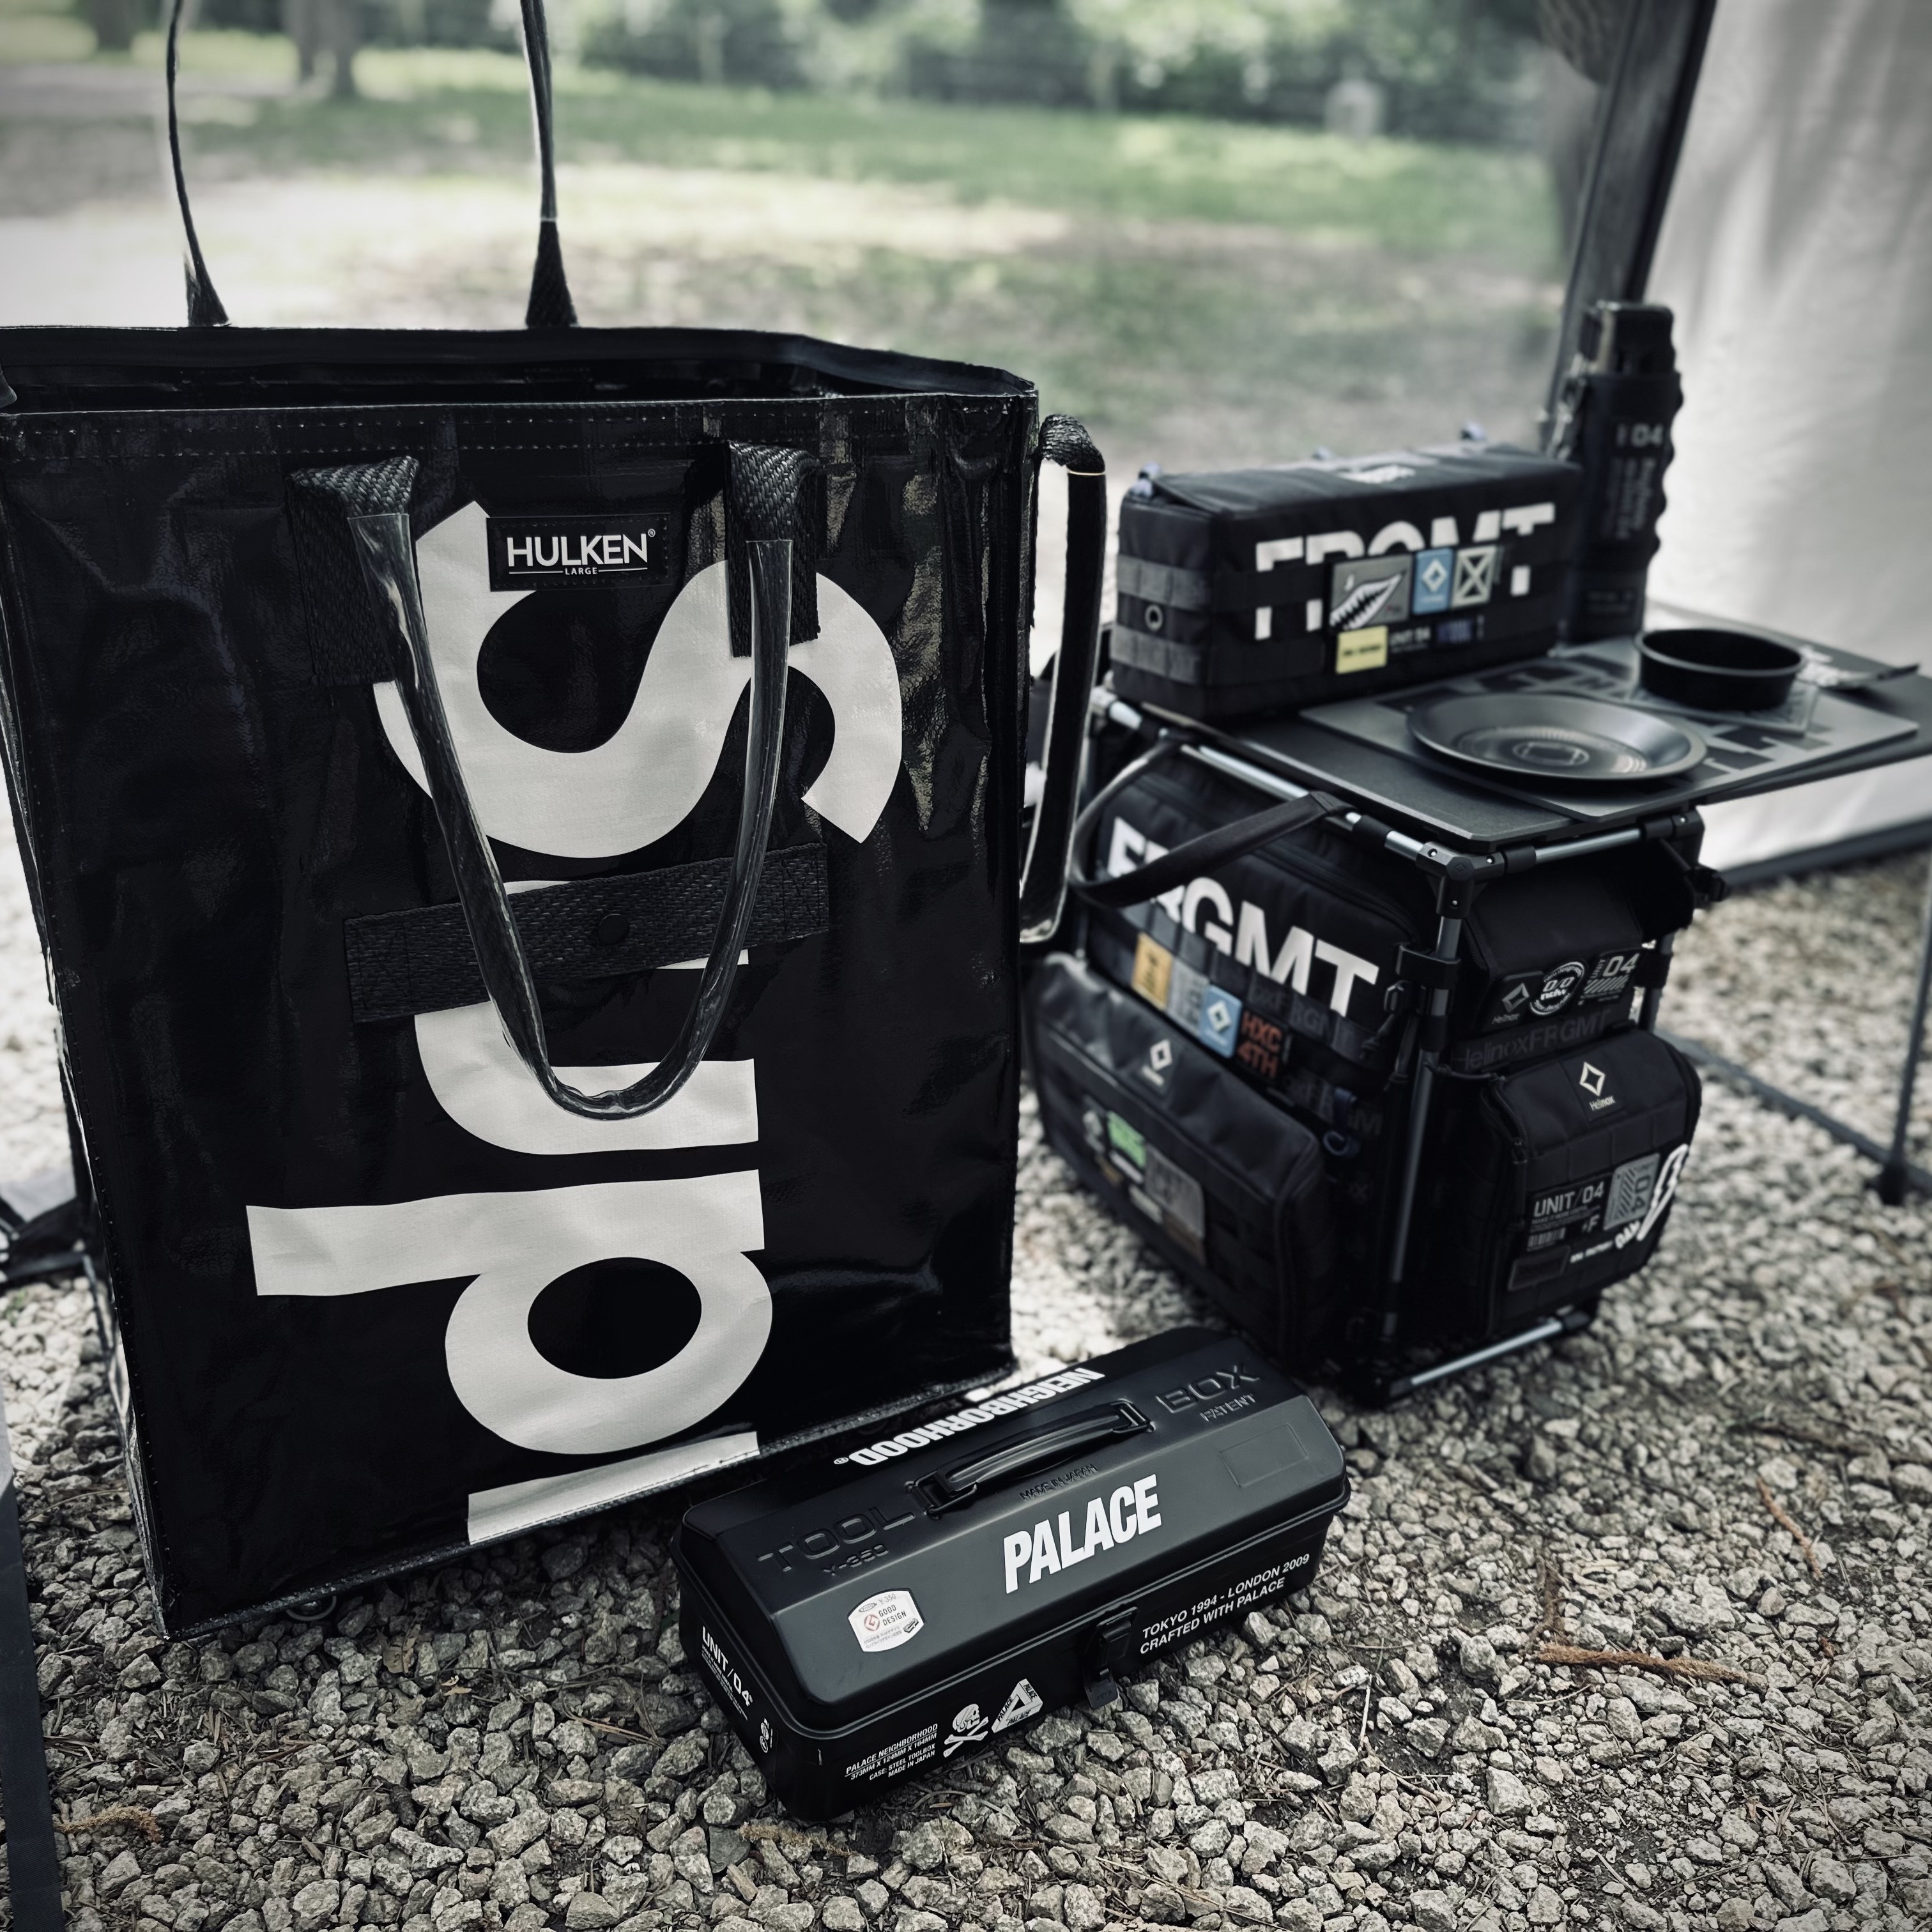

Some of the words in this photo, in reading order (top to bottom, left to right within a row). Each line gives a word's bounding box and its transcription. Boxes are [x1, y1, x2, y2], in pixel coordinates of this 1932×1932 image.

[1604, 953, 1639, 978] 04
[1590, 1095, 1615, 1111] Helinox
[1200, 1393, 1256, 1422] PATENT
[756, 1506, 916, 1572] TOOL
[1155, 1363, 1260, 1414] BOX
[1020, 1482, 1053, 1501] MADE
[1065, 1464, 1099, 1483] JAPAN
[1004, 1473, 1162, 1594] PALACE
[822, 1542, 889, 1576] Y-350
[878, 1604, 897, 1617] GOOD
[1142, 1609, 1188, 1639] TOKYO
[1191, 1595, 1218, 1616] 1994
[1228, 1565, 1280, 1598] LONDON
[1282, 1553, 1310, 1574] 2009
[882, 1610, 907, 1626] DESIGN
[1140, 1618, 1200, 1655] CRAFTED
[1203, 1603, 1234, 1624] WITH
[1236, 1577, 1285, 1609] PALACE
[846, 1747, 877, 1774] PALACE
[878, 1723, 938, 1758] NEIGHBORHOOD
[850, 1763, 875, 1780] 373MM
[883, 1747, 907, 1764] 124MM
[869, 1767, 887, 1781] CASE:
[888, 1758, 907, 1770] STEEL
[908, 1743, 935, 1761] TOOLBOX
[888, 1764, 907, 1777] MADE
[907, 1760, 914, 1768] IN
[915, 1750, 935, 1765] JAPAN
